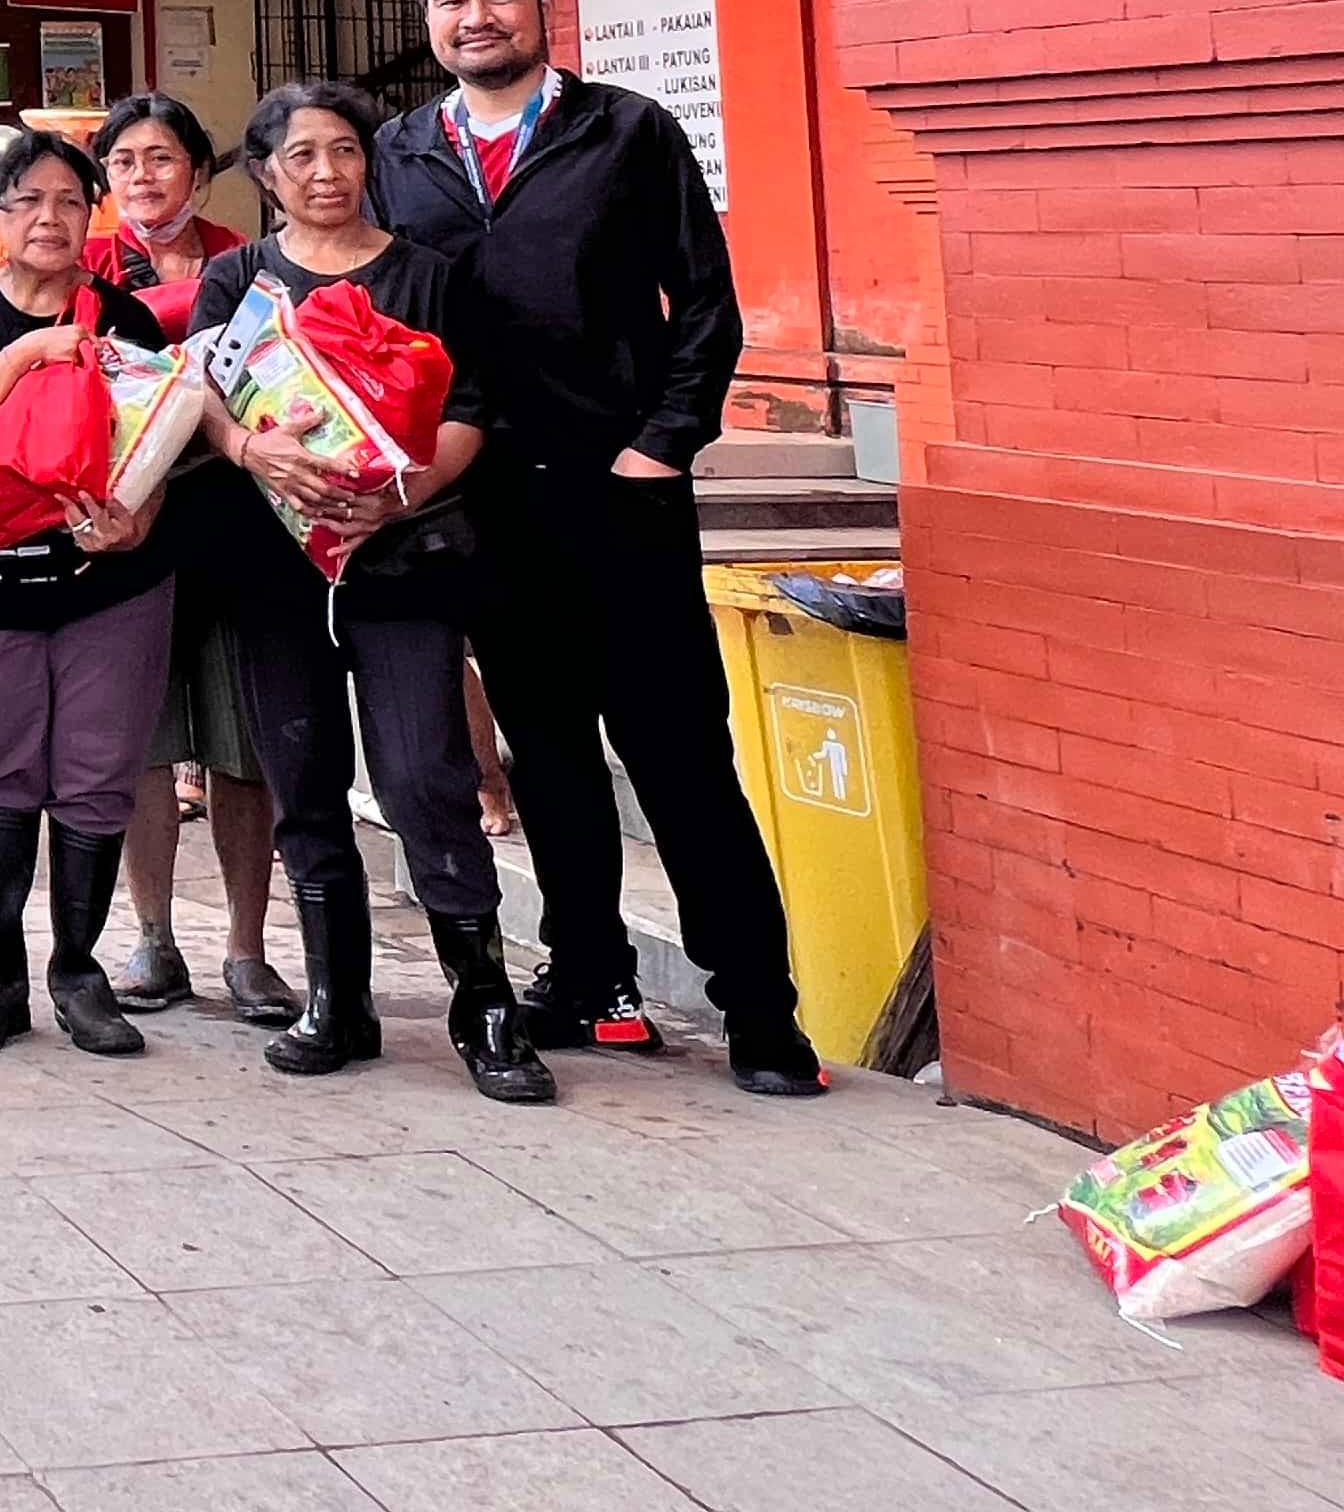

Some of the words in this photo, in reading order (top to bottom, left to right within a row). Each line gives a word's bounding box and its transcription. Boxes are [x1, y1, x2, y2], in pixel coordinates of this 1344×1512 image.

[595, 21, 633, 41] LANTAI
[660, 11, 712, 32] PAKAIAN
[597, 56, 635, 74] LANTAI
[662, 48, 711, 68] PATUNG
[664, 74, 716, 94] LUKISAN
